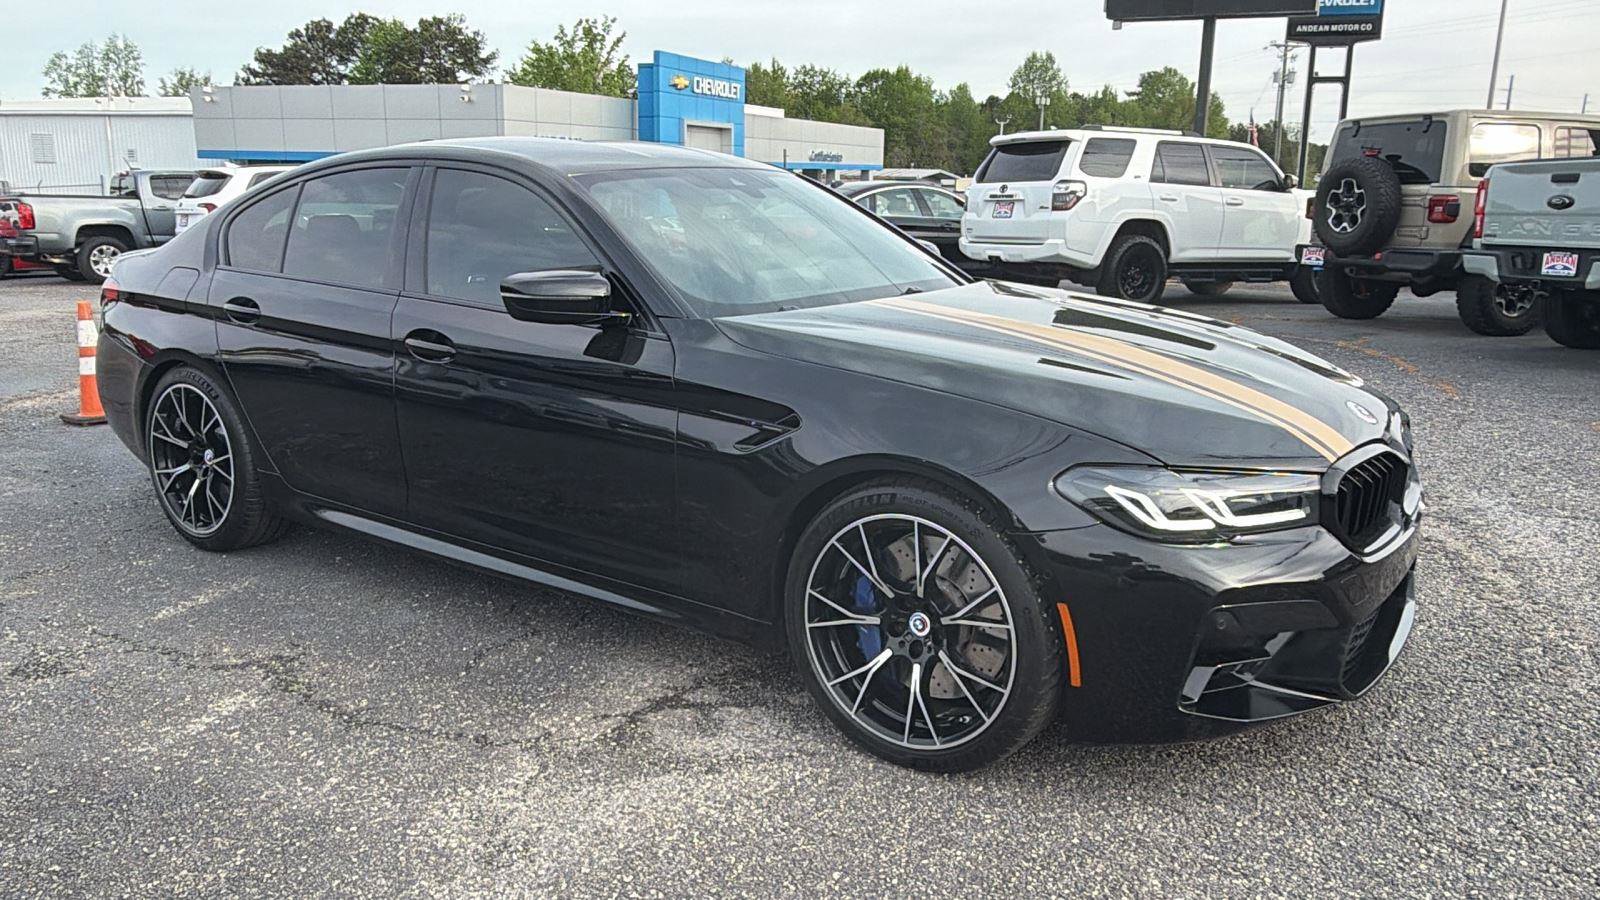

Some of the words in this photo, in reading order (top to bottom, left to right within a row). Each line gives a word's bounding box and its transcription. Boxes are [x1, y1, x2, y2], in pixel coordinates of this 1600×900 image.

[1360, 23, 1372, 31] CO
[693, 76, 741, 99] CHEVROLET
[1544, 255, 1577, 267] ANDEAN
